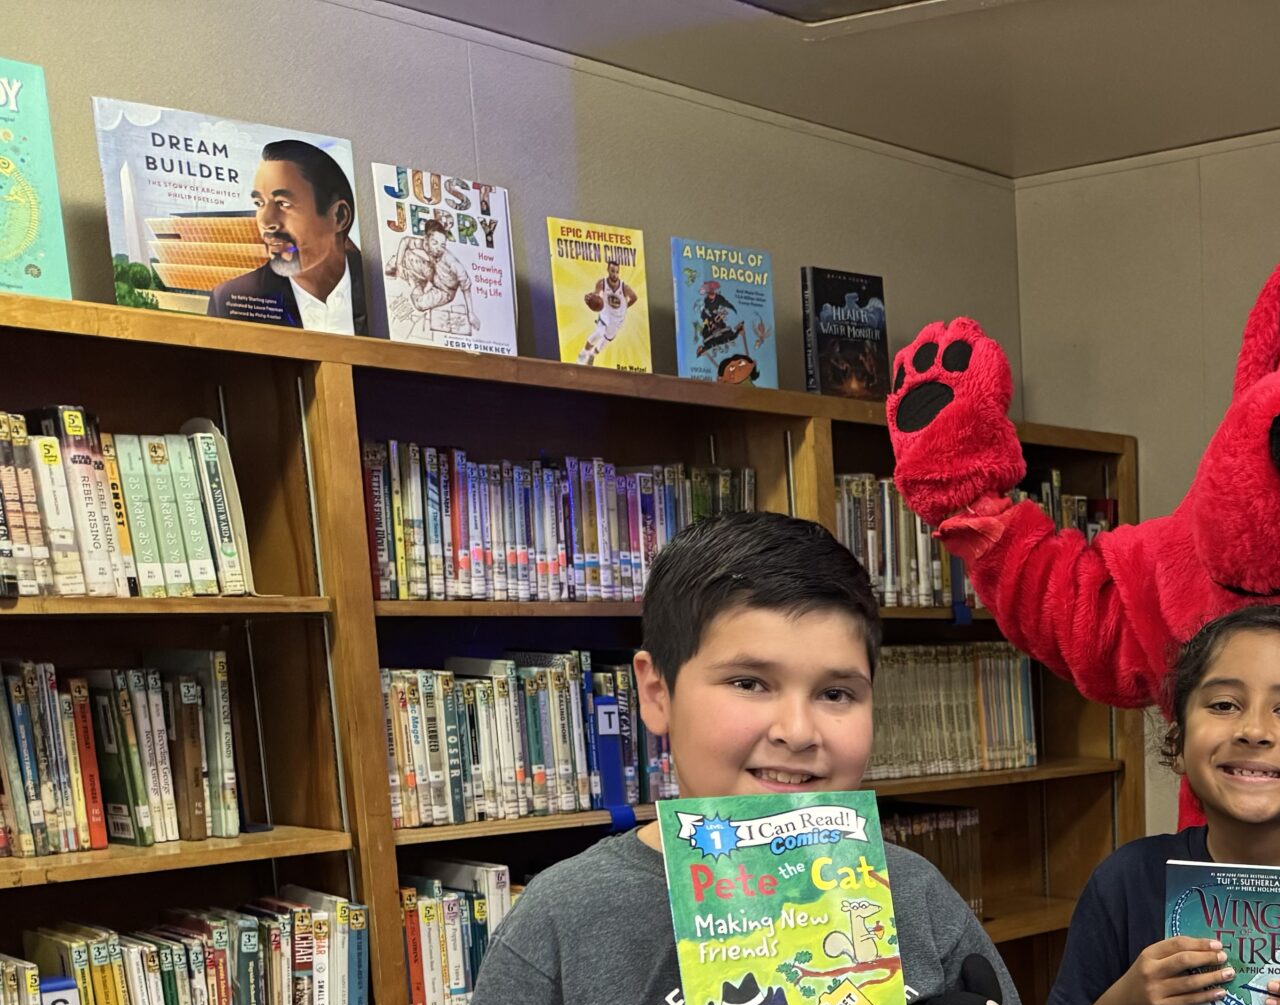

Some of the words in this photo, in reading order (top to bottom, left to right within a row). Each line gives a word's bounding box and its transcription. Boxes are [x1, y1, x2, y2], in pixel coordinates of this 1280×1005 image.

[151, 132, 229, 158] DREAM
[145, 155, 239, 184] BUILDER
[384, 166, 497, 217] JUST
[387, 202, 498, 249] JERRY
[560, 226, 582, 239] EPIC
[586, 230, 632, 245] ATHLETES
[478, 252, 495, 261] How
[556, 238, 601, 263] STEPHEN
[604, 244, 637, 267] CURRY
[683, 246, 692, 258] A
[697, 247, 744, 265] HATFUL
[748, 254, 763, 267] OF
[471, 262, 503, 278] Drawing
[474, 274, 502, 287] Shaped
[711, 265, 768, 286] DRAGONS
[476, 287, 488, 298] My
[489, 288, 502, 297] Life
[820, 321, 846, 336] WATER
[847, 326, 880, 341] MONSTER
[80, 475, 94, 509] REBEL
[87, 510, 102, 550] RISING
[110, 482, 125, 527] GHOST
[131, 495, 147, 528] brave
[159, 495, 175, 528] brave
[182, 492, 198, 526] brave
[603, 711, 616, 729] T
[446, 725, 461, 778] LOSER
[705, 823, 725, 831] LEVEL
[709, 830, 723, 850] 1
[746, 825, 755, 841] I
[758, 822, 797, 839] Can
[799, 812, 851, 829] Read!
[770, 827, 842, 856] Comics
[690, 863, 779, 903] Pete
[778, 861, 806, 880] the
[810, 856, 878, 891] Cat
[1216, 877, 1231, 885] TUI
[694, 908, 777, 938] Making
[780, 908, 830, 933] New
[1240, 928, 1252, 936] OF
[697, 938, 781, 965] Friends
